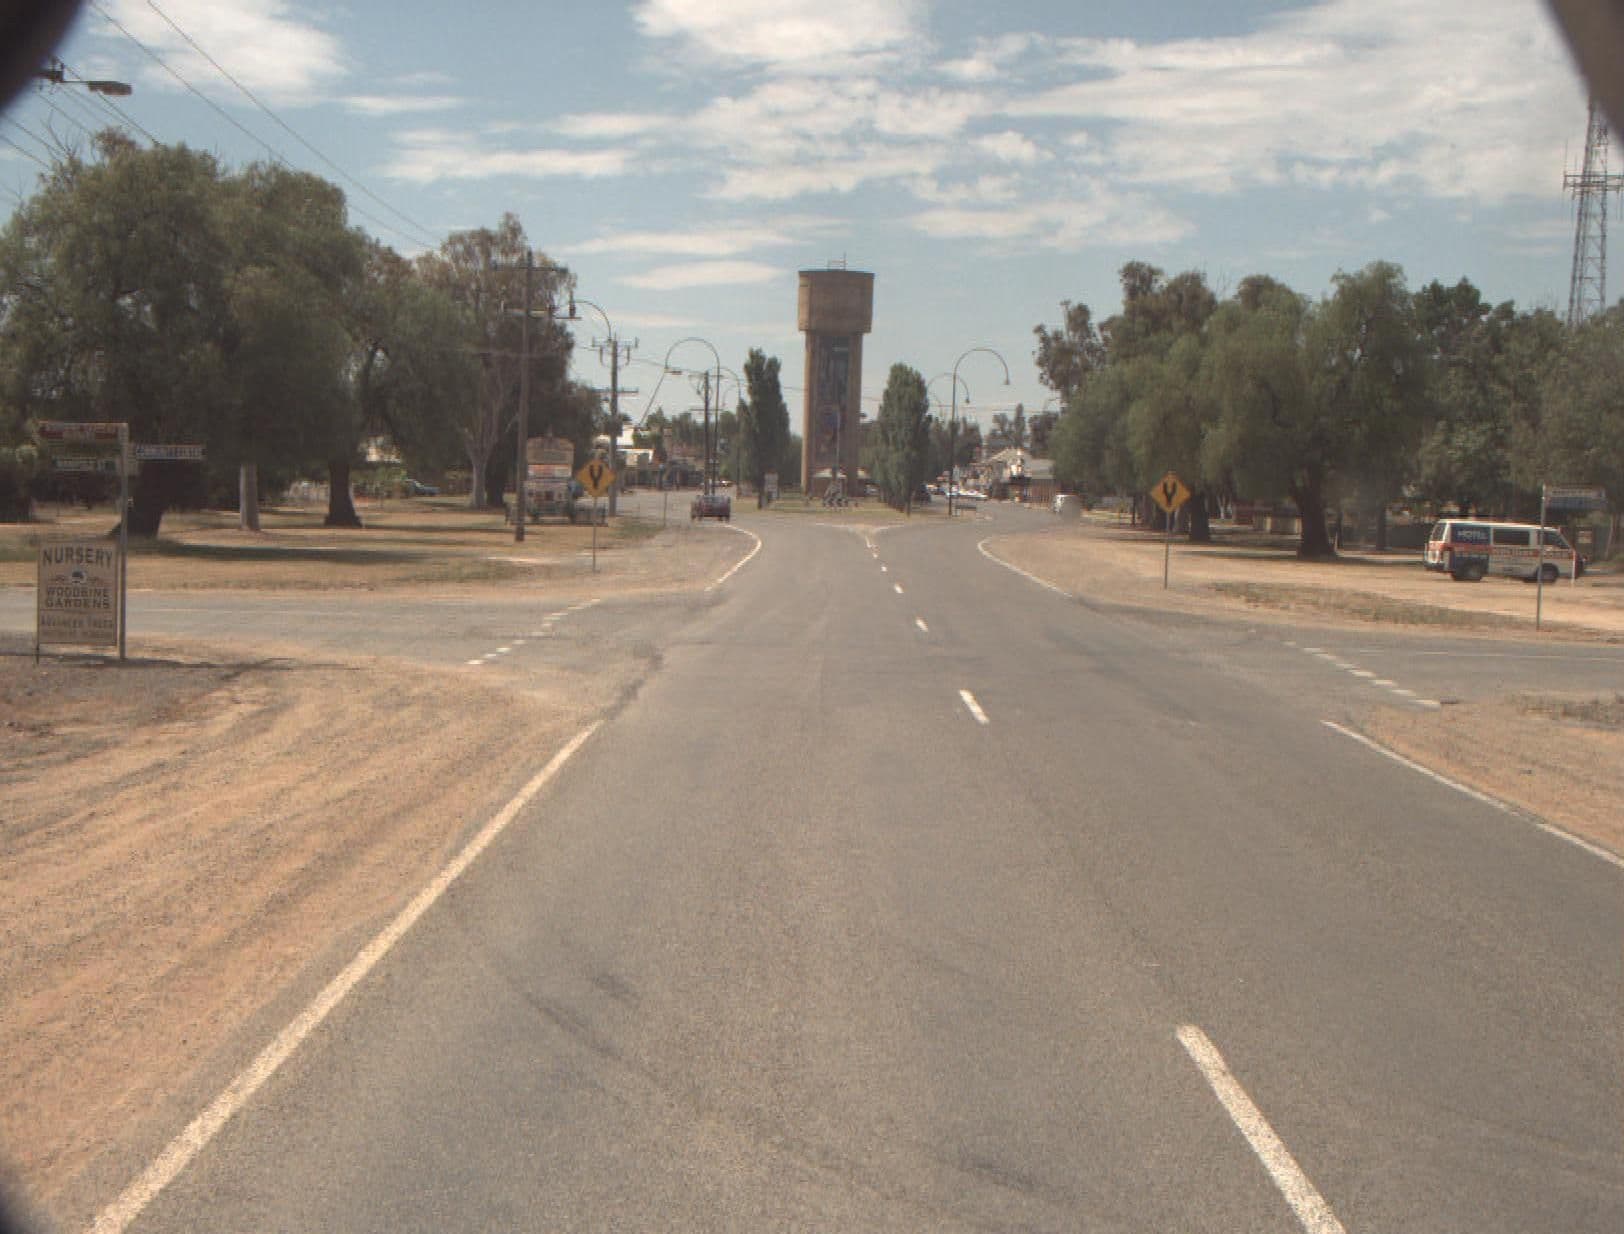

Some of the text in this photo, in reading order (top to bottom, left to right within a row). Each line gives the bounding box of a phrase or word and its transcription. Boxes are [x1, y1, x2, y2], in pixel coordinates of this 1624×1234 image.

[43, 546, 113, 568] NURSERY
[47, 587, 110, 598] WOODBINE
[45, 598, 111, 609] GARDENS
